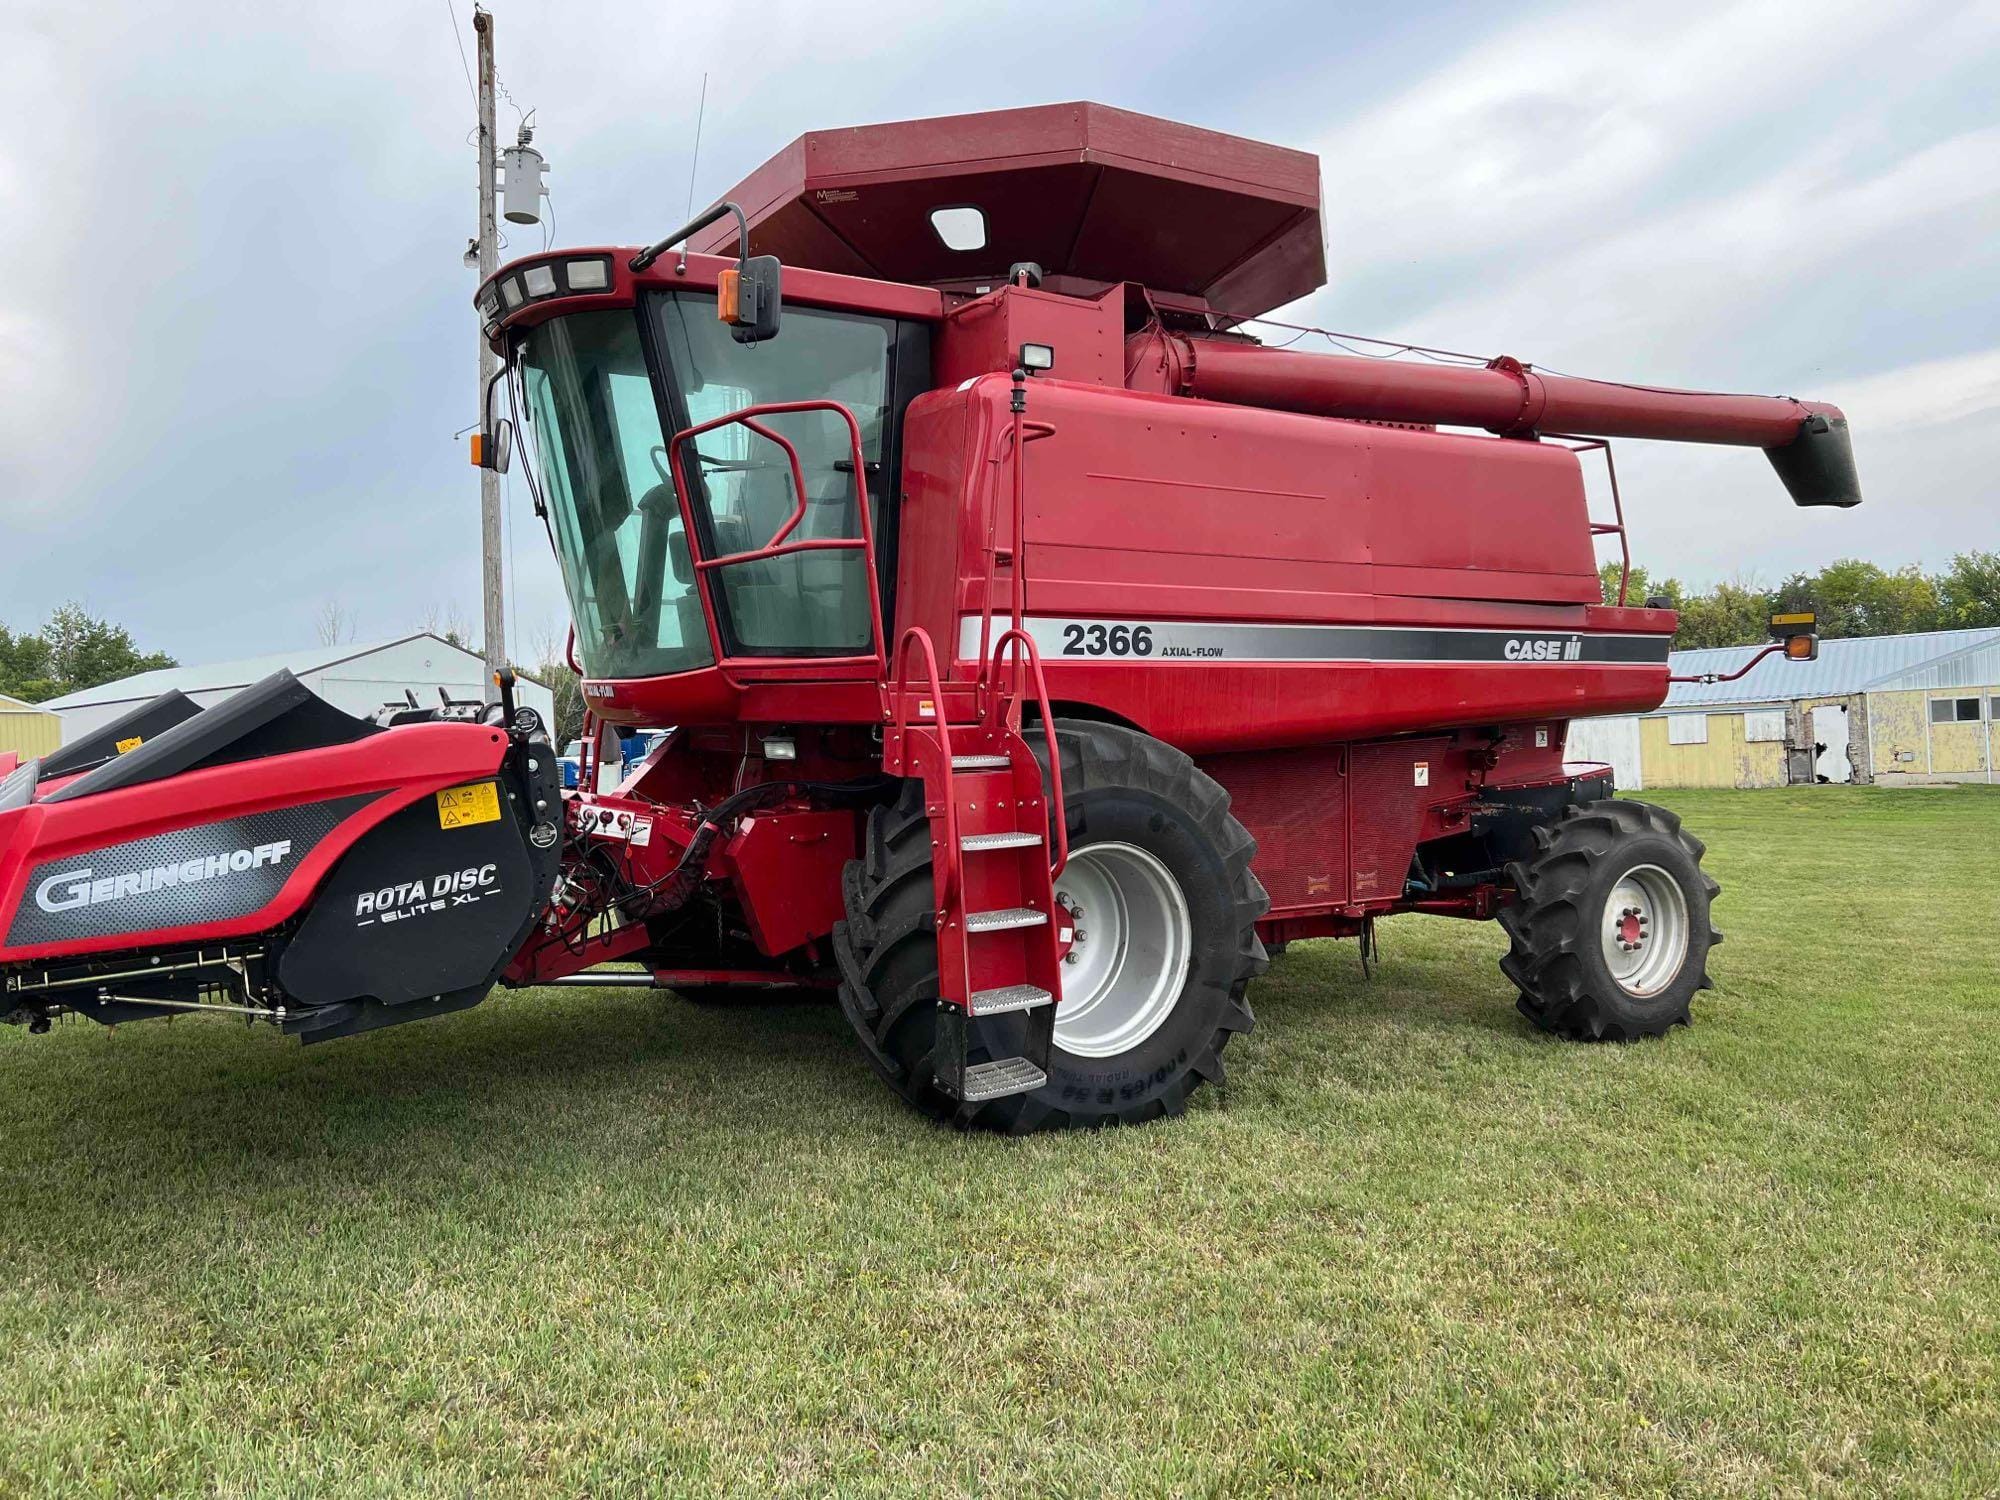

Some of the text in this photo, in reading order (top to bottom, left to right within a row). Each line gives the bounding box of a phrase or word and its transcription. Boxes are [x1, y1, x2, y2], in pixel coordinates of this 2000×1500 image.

[1063, 624, 1224, 657] 2366 AXIAL-FLOW
[1504, 639, 1562, 660] CASE
[35, 839, 292, 913] GERINGHOFF
[355, 863, 497, 916] ROTA DISC
[380, 893, 480, 923] ELITE XL
